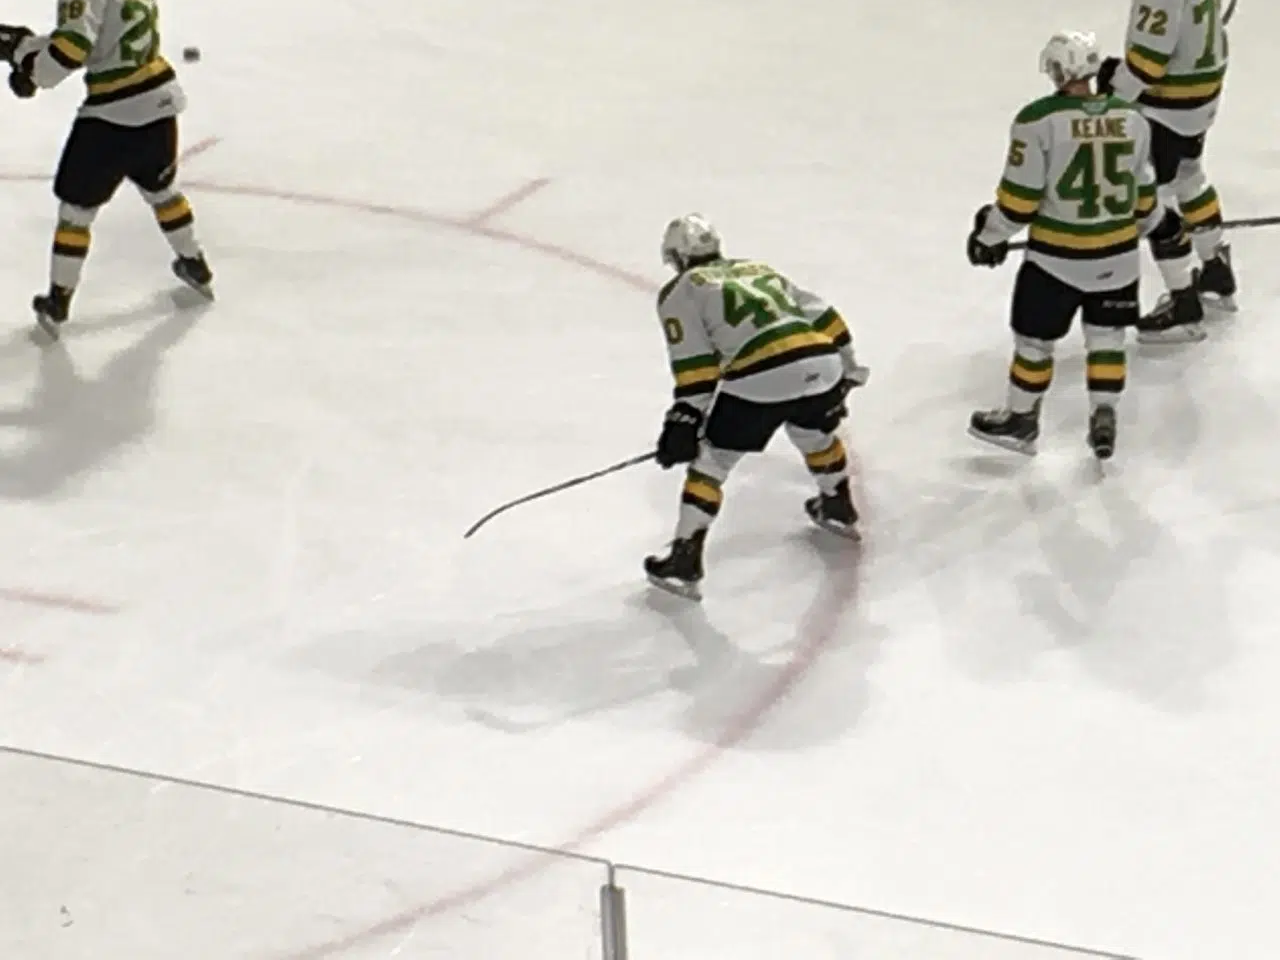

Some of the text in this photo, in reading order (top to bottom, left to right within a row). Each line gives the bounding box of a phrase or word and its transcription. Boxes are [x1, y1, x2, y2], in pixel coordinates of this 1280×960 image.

[1138, 5, 1169, 36] 72
[1071, 117, 1127, 139] KEANE
[1056, 142, 1136, 219] 45
